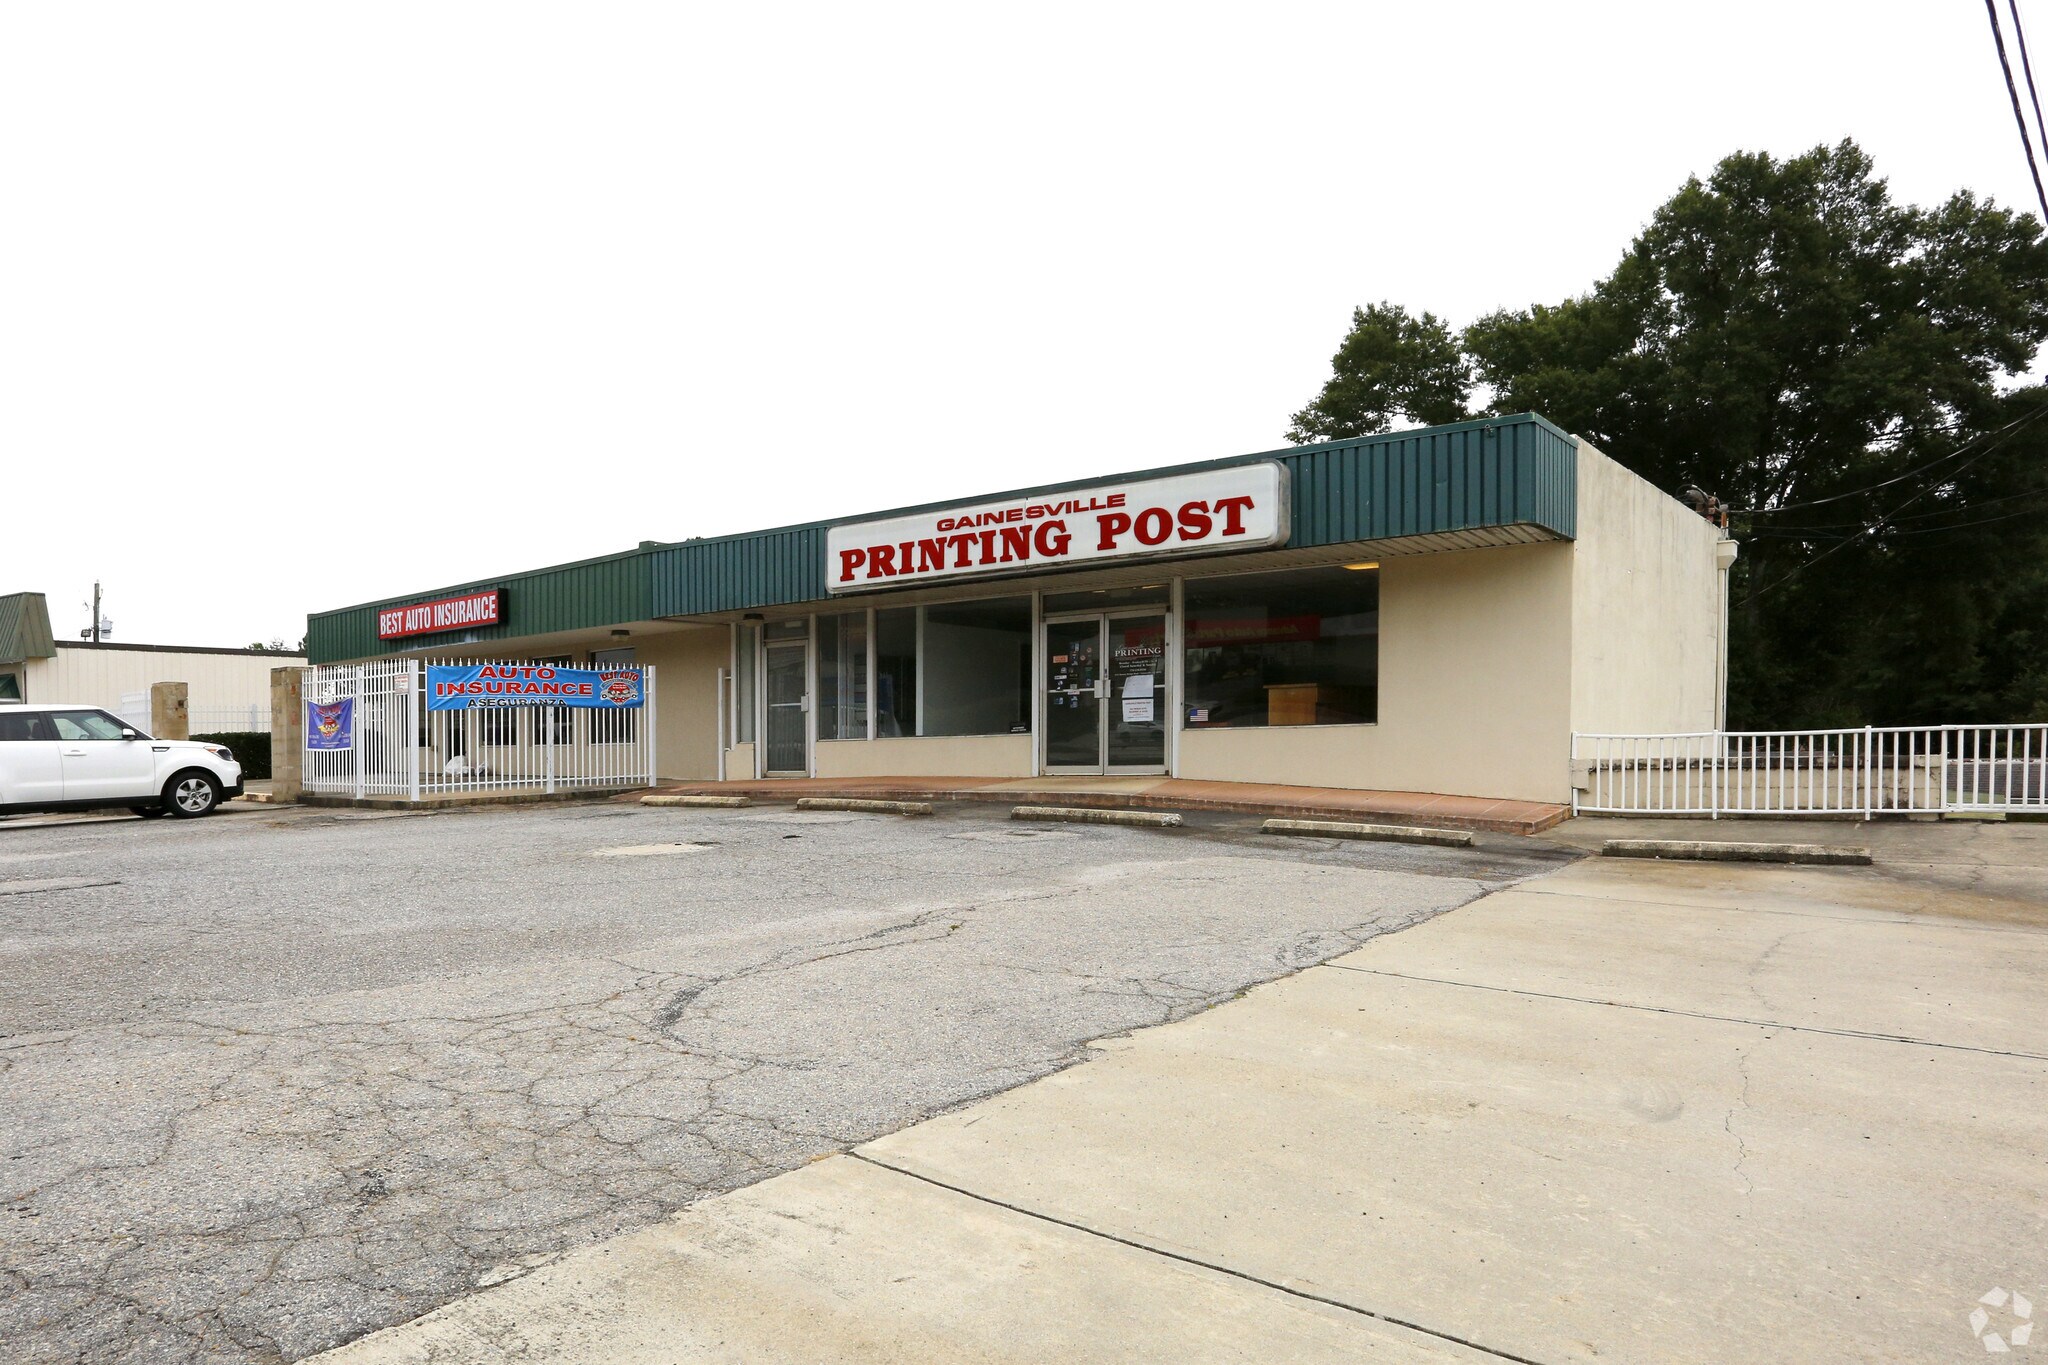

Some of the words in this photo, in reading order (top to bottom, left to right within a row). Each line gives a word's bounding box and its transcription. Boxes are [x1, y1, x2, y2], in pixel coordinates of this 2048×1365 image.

[936, 493, 1126, 532] GAINESVILLE
[839, 519, 1072, 582] PRINTING
[1096, 495, 1255, 551] POST
[380, 611, 402, 636] BEST
[405, 606, 431, 631] AUTO
[434, 595, 496, 625] INSURANCE
[1114, 647, 1162, 657] PRINTING
[478, 665, 556, 679] AUTO
[619, 671, 639, 682] AUTO
[436, 681, 593, 696] INSURANCE
[467, 697, 567, 707] ASEGURANZA
